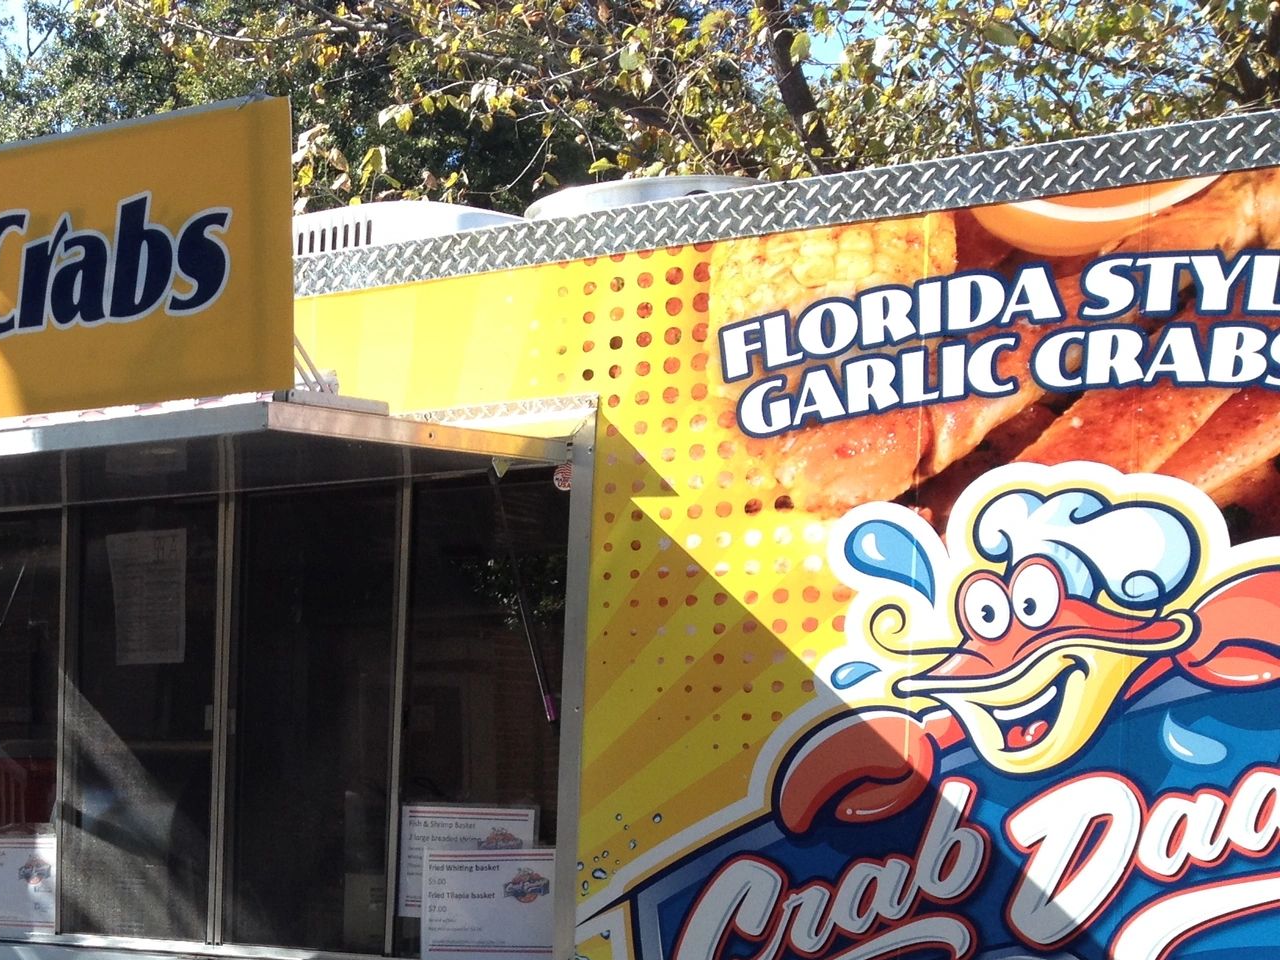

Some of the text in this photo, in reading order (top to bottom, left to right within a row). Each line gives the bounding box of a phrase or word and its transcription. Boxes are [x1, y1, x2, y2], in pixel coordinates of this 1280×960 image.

[722, 266, 1062, 382] FLORIDA
[738, 337, 1017, 437] GARLIC
[429, 864, 445, 872] Fried
[446, 863, 474, 873] Whiting
[475, 864, 500, 872] basket
[446, 892, 470, 901] Tilapia
[471, 892, 496, 900] basket
